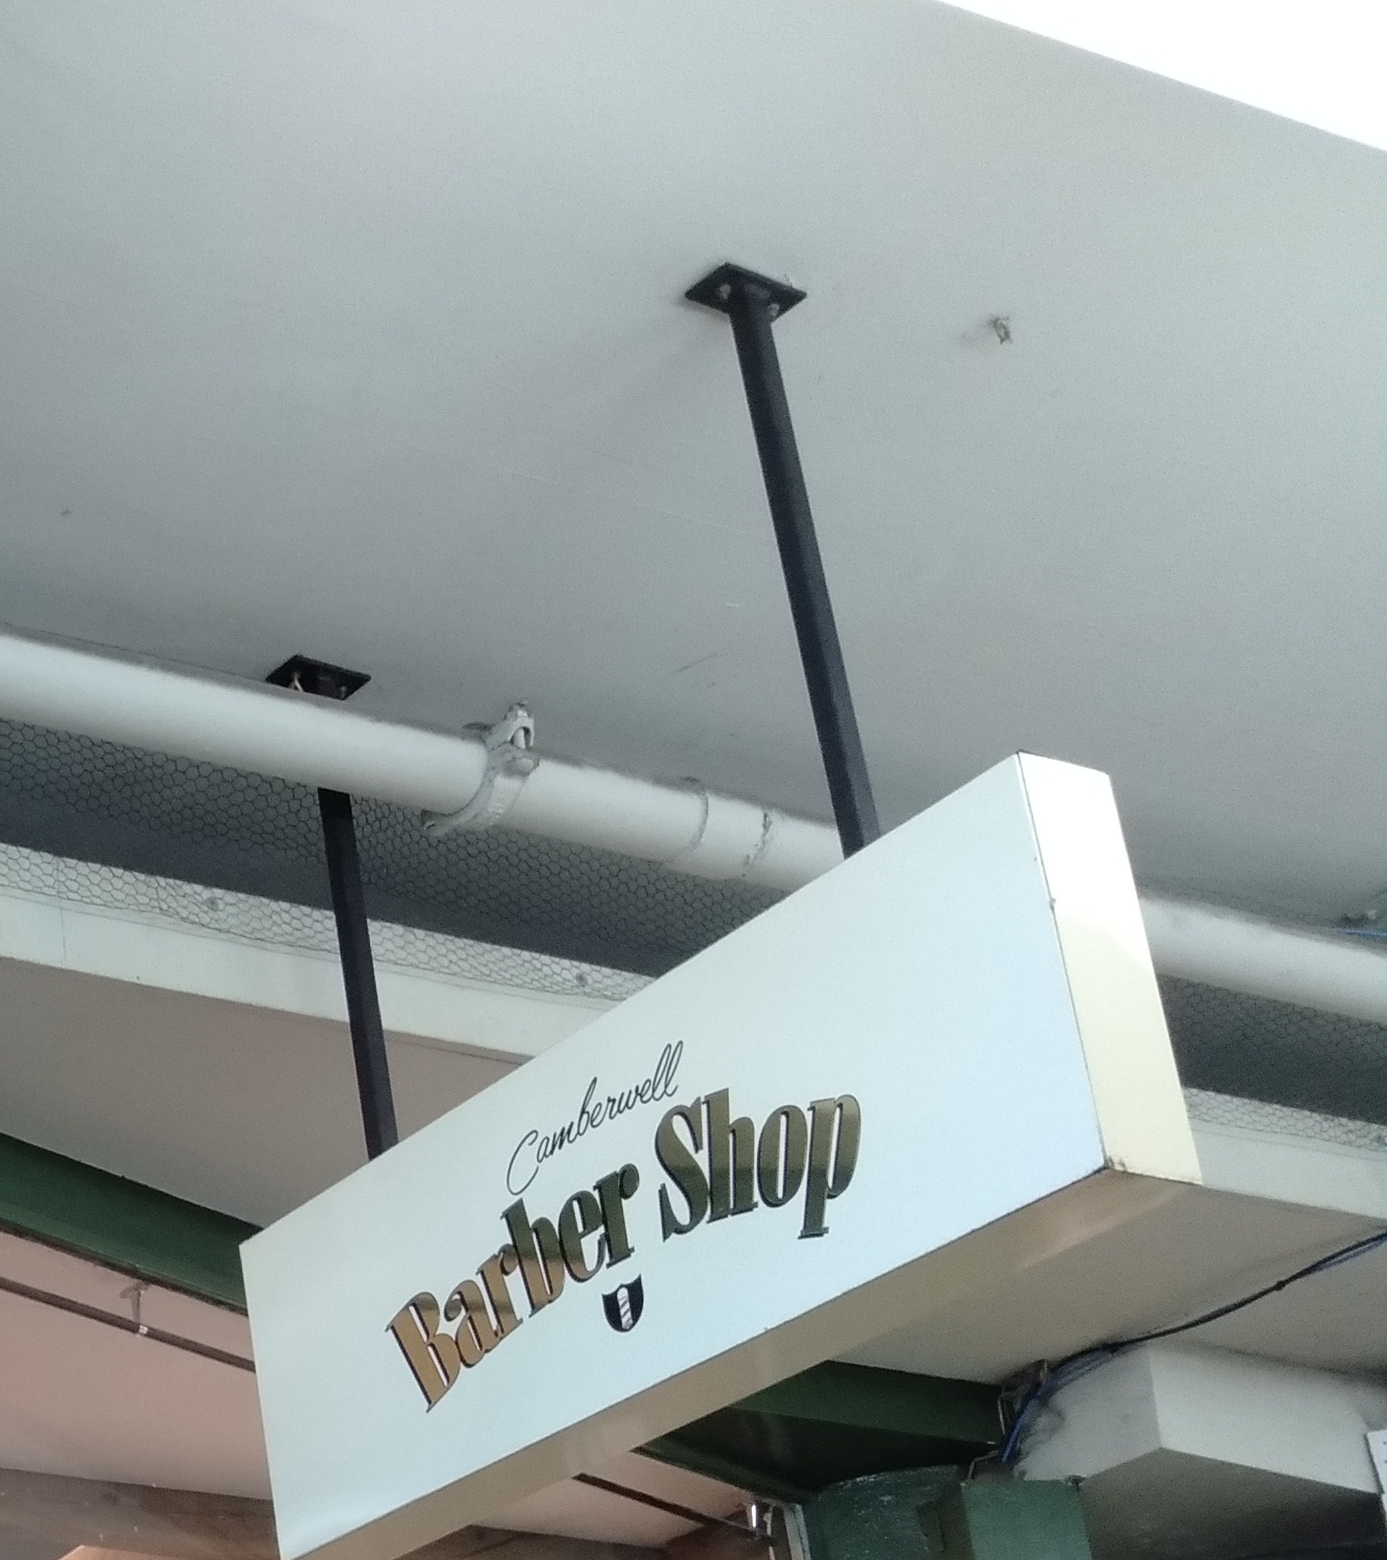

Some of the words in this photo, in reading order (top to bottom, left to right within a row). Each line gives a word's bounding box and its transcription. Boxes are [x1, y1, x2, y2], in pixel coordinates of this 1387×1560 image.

[506, 1040, 684, 1195] Camberwell
[385, 1163, 640, 1414] Barber
[654, 1087, 862, 1243] Shop
